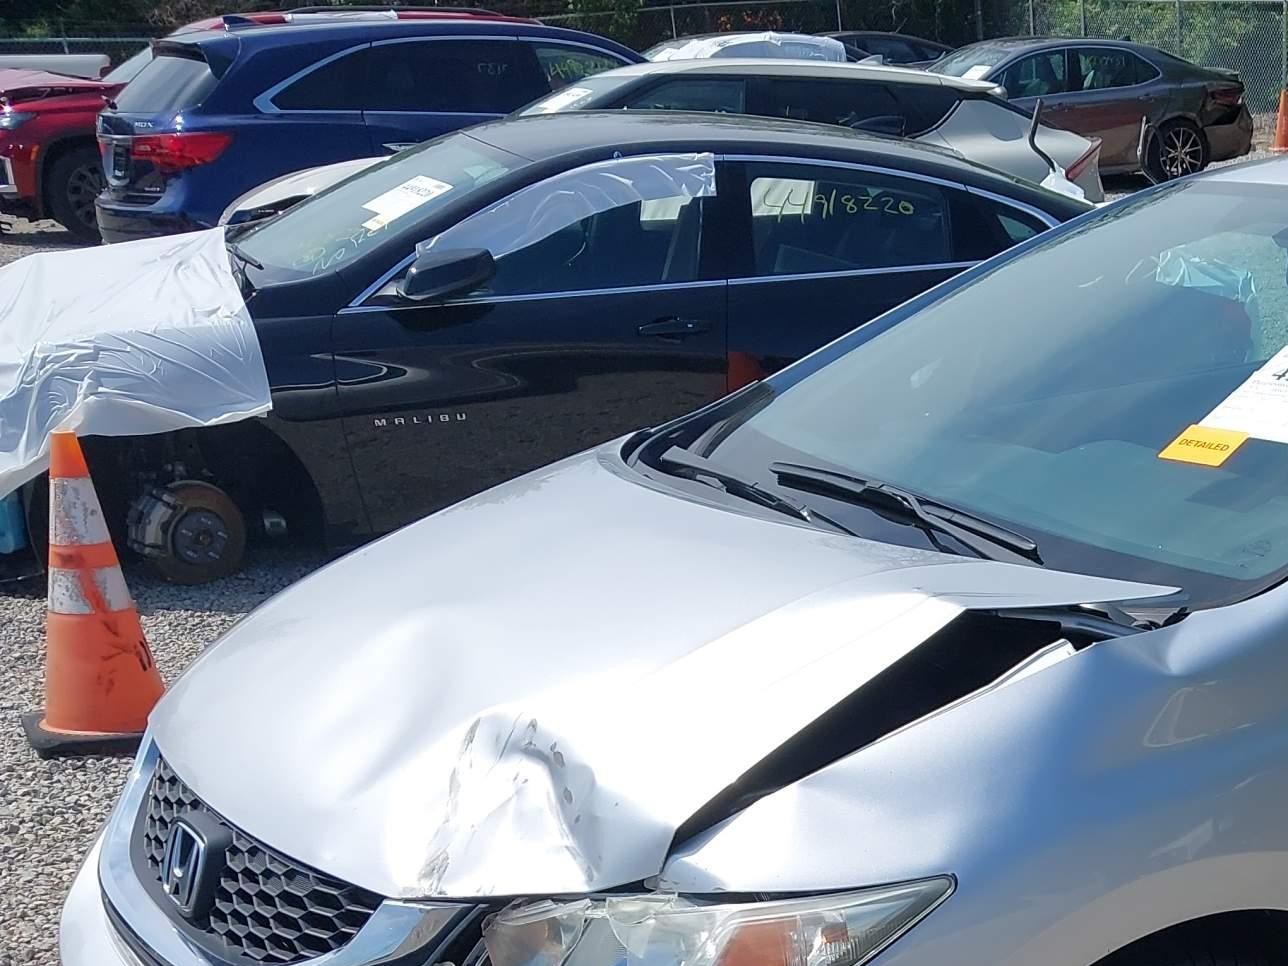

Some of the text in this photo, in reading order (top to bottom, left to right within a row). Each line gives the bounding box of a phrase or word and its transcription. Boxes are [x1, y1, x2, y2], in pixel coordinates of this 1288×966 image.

[763, 188, 914, 224] 44918220
[374, 413, 466, 427] MALIBU
[1178, 438, 1230, 451] DETAILED
